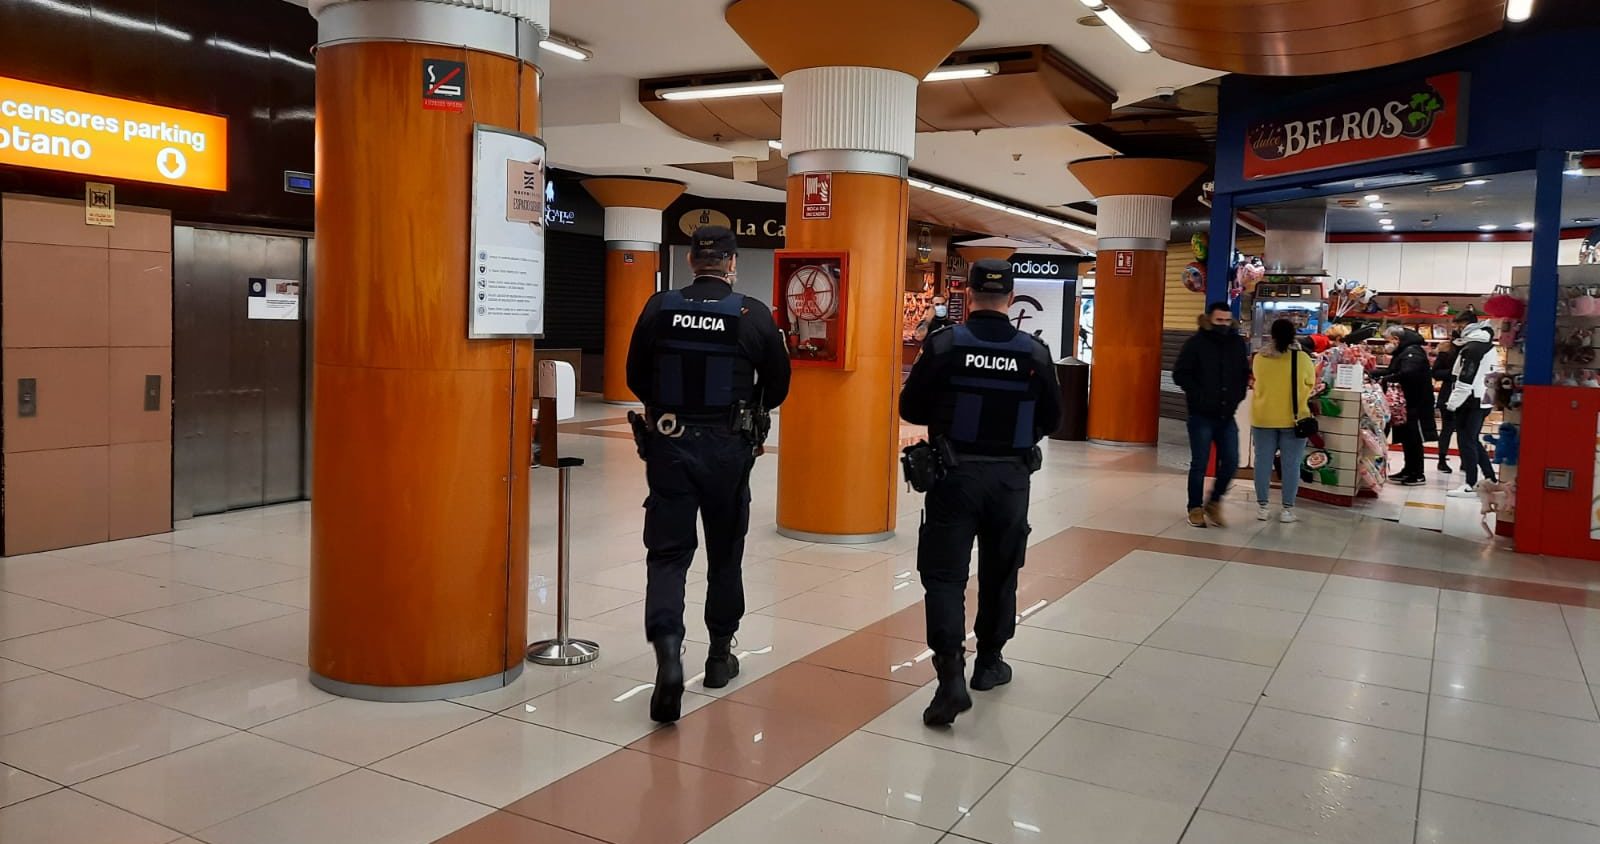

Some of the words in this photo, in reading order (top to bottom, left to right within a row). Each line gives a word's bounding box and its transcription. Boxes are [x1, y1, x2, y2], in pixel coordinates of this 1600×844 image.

[0, 99, 119, 132] censores
[124, 121, 206, 151] parking
[1253, 129, 1281, 149] dulce
[1284, 101, 1408, 158] BELROS
[0, 125, 92, 160] otano
[736, 218, 757, 236] La
[1012, 260, 1059, 275] ndiodo
[672, 314, 725, 331] POLICIA
[965, 354, 1018, 372] POLICIA
